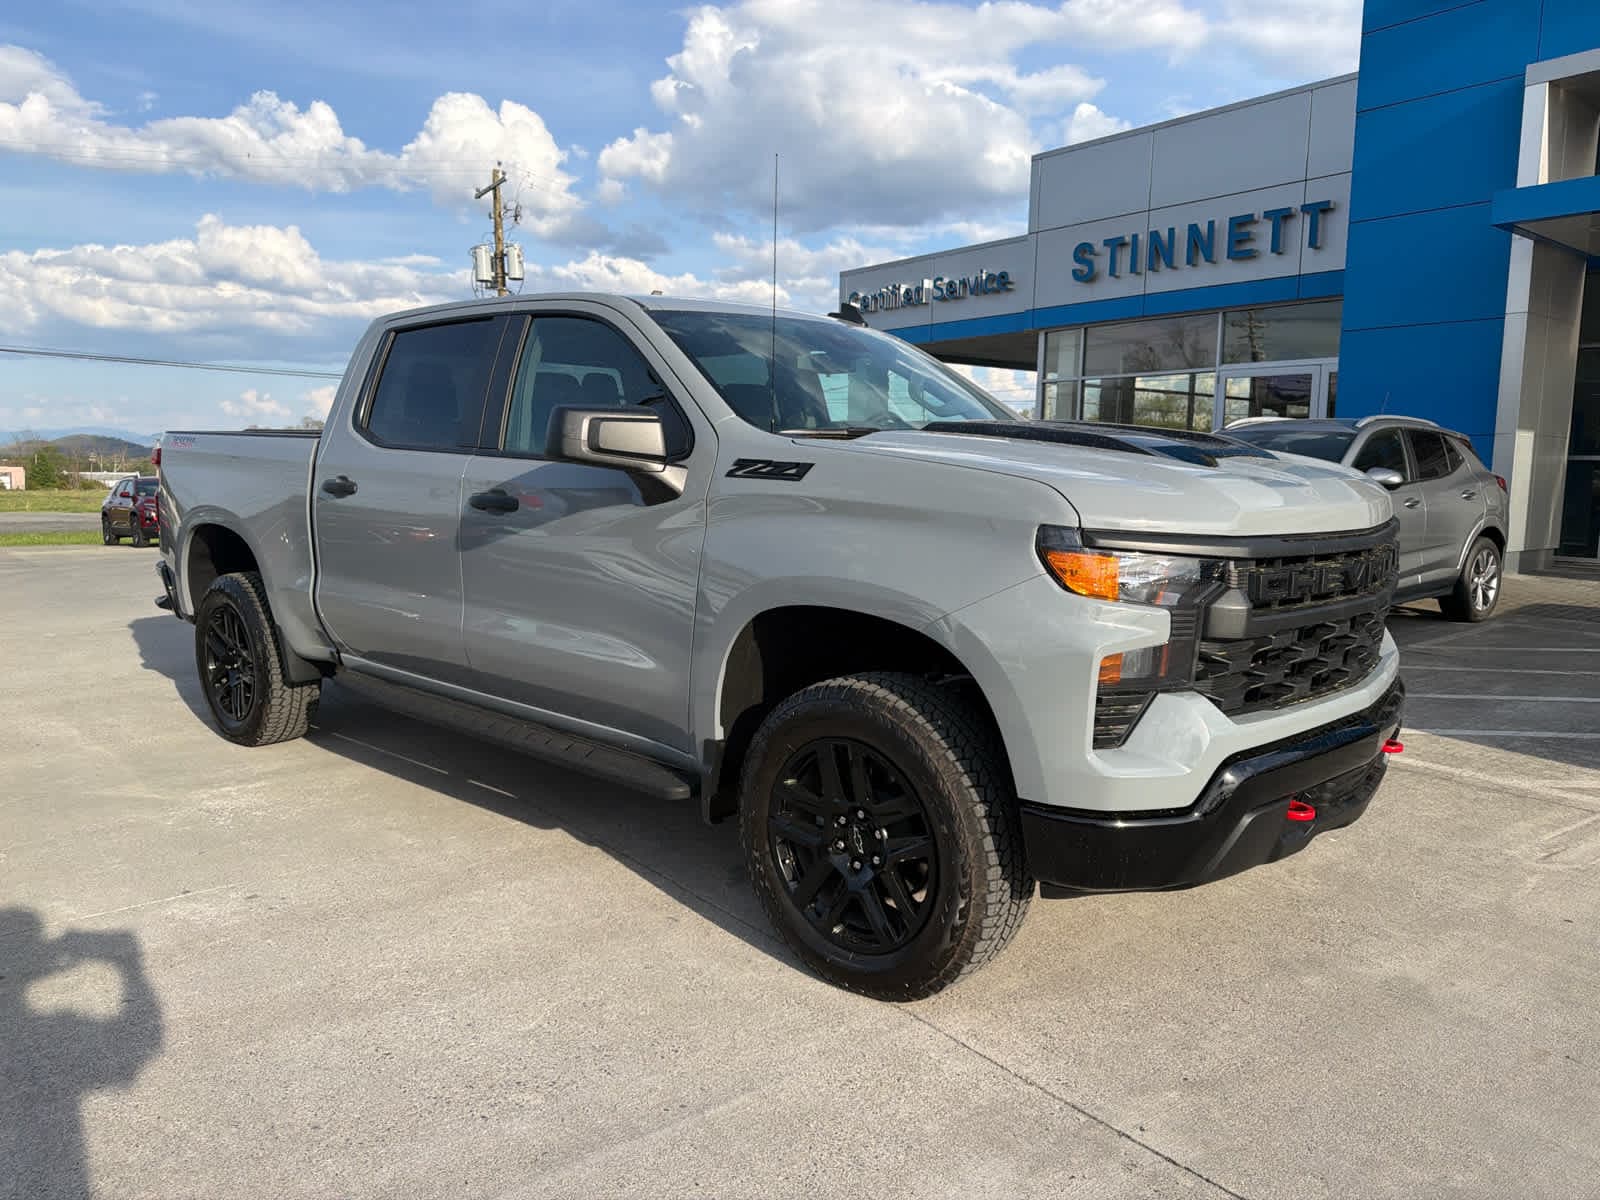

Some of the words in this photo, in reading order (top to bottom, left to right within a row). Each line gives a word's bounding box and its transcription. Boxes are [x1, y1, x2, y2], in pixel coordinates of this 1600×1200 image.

[1072, 200, 1333, 283] STINNETT
[848, 279, 925, 313] Certified
[932, 268, 1011, 302] Service
[724, 458, 816, 482] Z71
